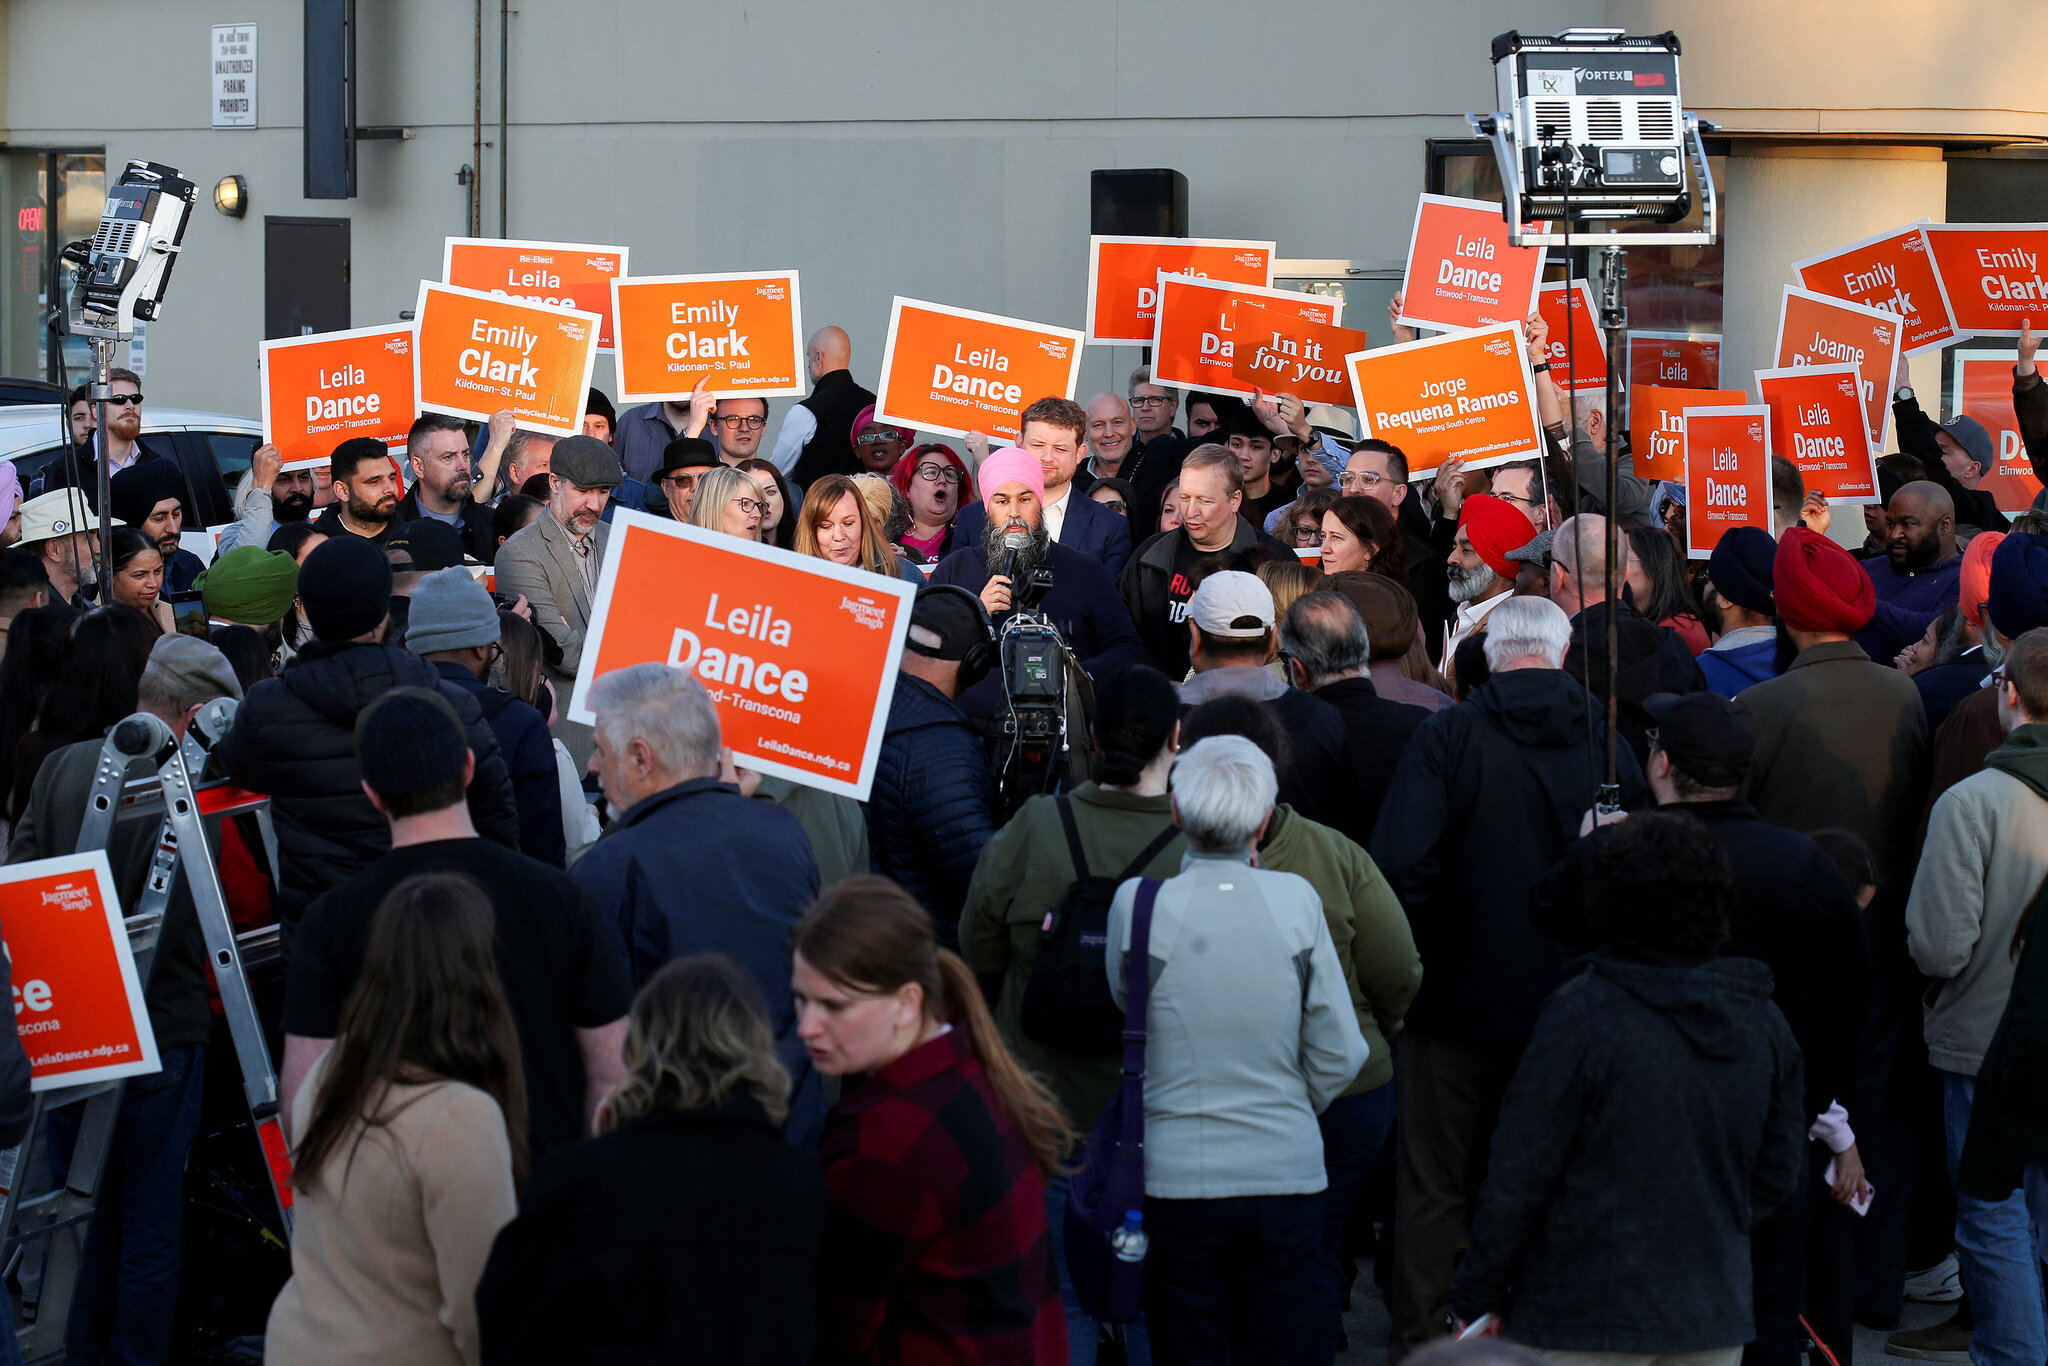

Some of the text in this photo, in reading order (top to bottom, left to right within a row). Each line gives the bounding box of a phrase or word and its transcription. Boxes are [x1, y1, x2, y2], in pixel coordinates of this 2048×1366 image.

[215, 59, 253, 74] UNAUTHORIZED
[223, 79, 246, 93] PARKING
[219, 98, 249, 112] PROHIBITED
[18, 207, 42, 231] OPEN
[1455, 235, 1495, 260] Leila
[520, 255, 553, 264] Re-Elect
[586, 258, 614, 267] Jagmeet
[596, 264, 613, 272] Singh
[1234, 254, 1262, 263] Jagmeet
[1244, 260, 1262, 268] Singh
[1976, 247, 2037, 273] Emily
[508, 269, 560, 289] Leila
[1437, 259, 1502, 292] Dance
[1843, 262, 1896, 295] Emily
[756, 286, 784, 295] Jagmeet
[767, 292, 784, 301] Singh
[1981, 275, 2048, 300] Clark
[671, 300, 739, 327] Emily
[1299, 308, 1327, 318] Jagmeet
[471, 318, 538, 356] Emily
[557, 323, 585, 334] Jagmeet
[567, 331, 584, 341] Singh
[384, 340, 408, 350] Jagmeet
[393, 346, 408, 355] Singh
[666, 329, 749, 359] Clark
[1038, 341, 1067, 353] Jagmeet
[1048, 349, 1066, 359] Singh
[1271, 331, 1323, 361] In it
[1483, 341, 1510, 353] Jagmeet
[1809, 331, 1864, 365] Joanne
[459, 348, 540, 388] Clark
[729, 360, 750, 370] Paul
[954, 343, 1009, 372] Leila
[1249, 346, 1290, 372] for
[1291, 363, 1342, 384] you
[320, 364, 365, 389] Leila
[731, 376, 789, 385] EmilyClark.ndp.ca
[1660, 362, 1688, 381] Leila
[515, 388, 536, 401] Paul
[931, 364, 1022, 404] Dance
[1420, 377, 1467, 399] Jorge
[306, 393, 380, 421] Dance
[1375, 390, 1519, 430] Requena Ramos
[1798, 402, 1831, 426] Leila
[1416, 415, 1486, 434] Winnipeg South Centre
[1448, 437, 1531, 458] JorgeRequenaRamos.ndp.ca
[1646, 430, 1680, 460] for
[1793, 432, 1845, 459] Dance
[1712, 446, 1738, 471] Leila
[1706, 477, 1747, 506] Dance
[839, 597, 886, 619] Jagmeet
[705, 593, 792, 647] Leila
[854, 611, 883, 630] Singh
[667, 627, 809, 703] Dance
[757, 736, 850, 772] LeilaDance.ndp.ca
[40, 886, 90, 906] Jagmeet
[61, 897, 92, 911] Singh
